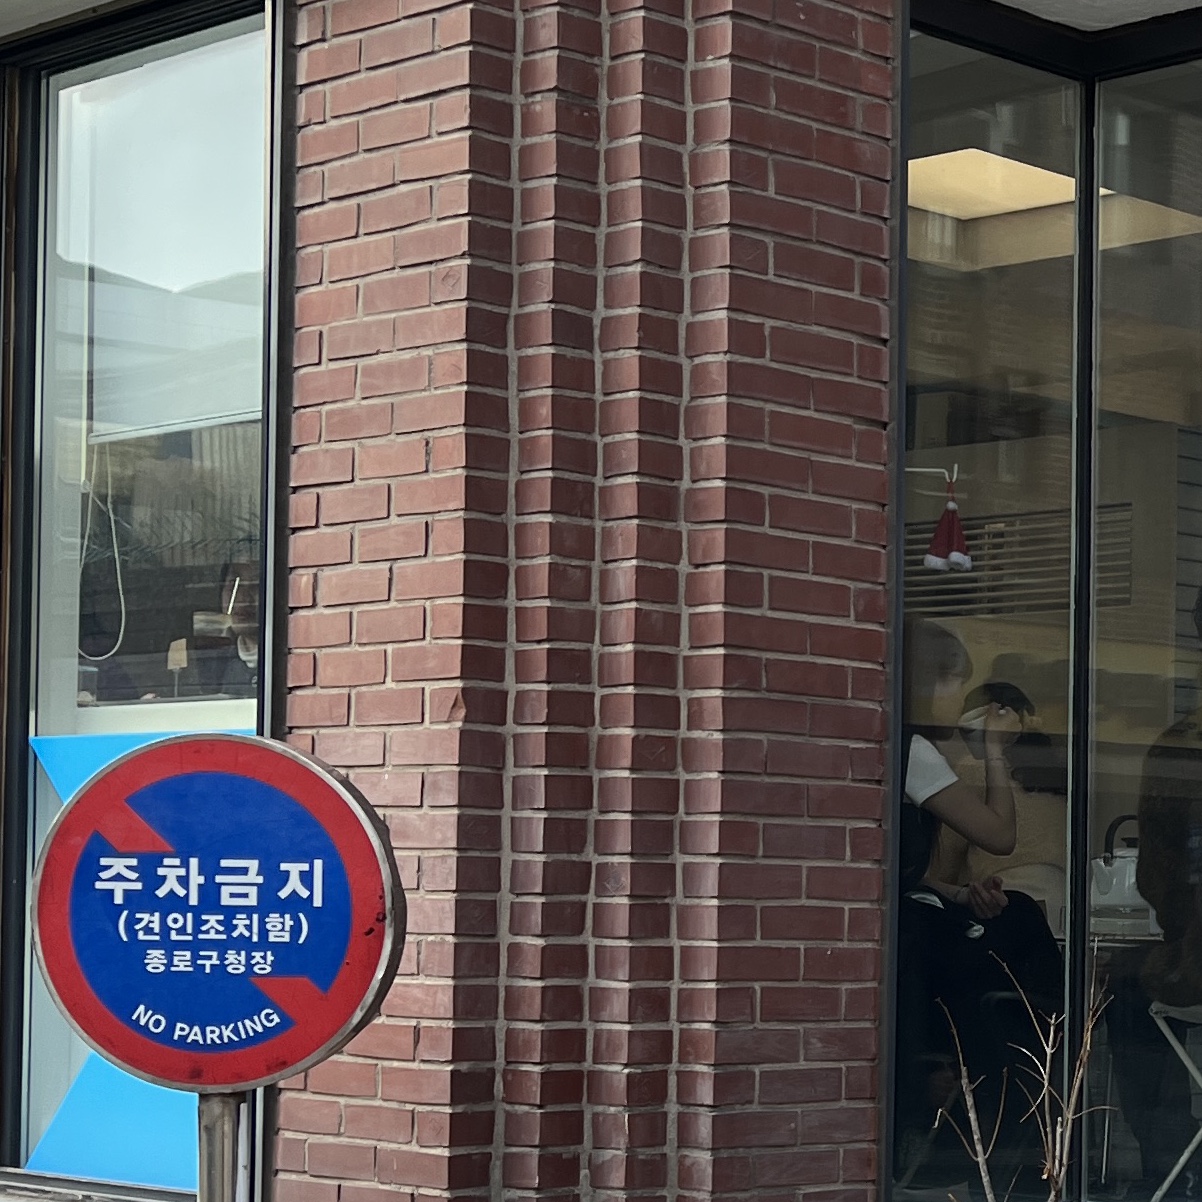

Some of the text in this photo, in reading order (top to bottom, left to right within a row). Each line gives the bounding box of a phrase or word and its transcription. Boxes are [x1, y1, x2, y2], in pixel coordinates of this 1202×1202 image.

[94, 857, 324, 907] 주차금지
[117, 910, 310, 944] (견인조치함)
[143, 950, 275, 974] 종로구청장
[132, 1004, 281, 1045] NO PARKING
